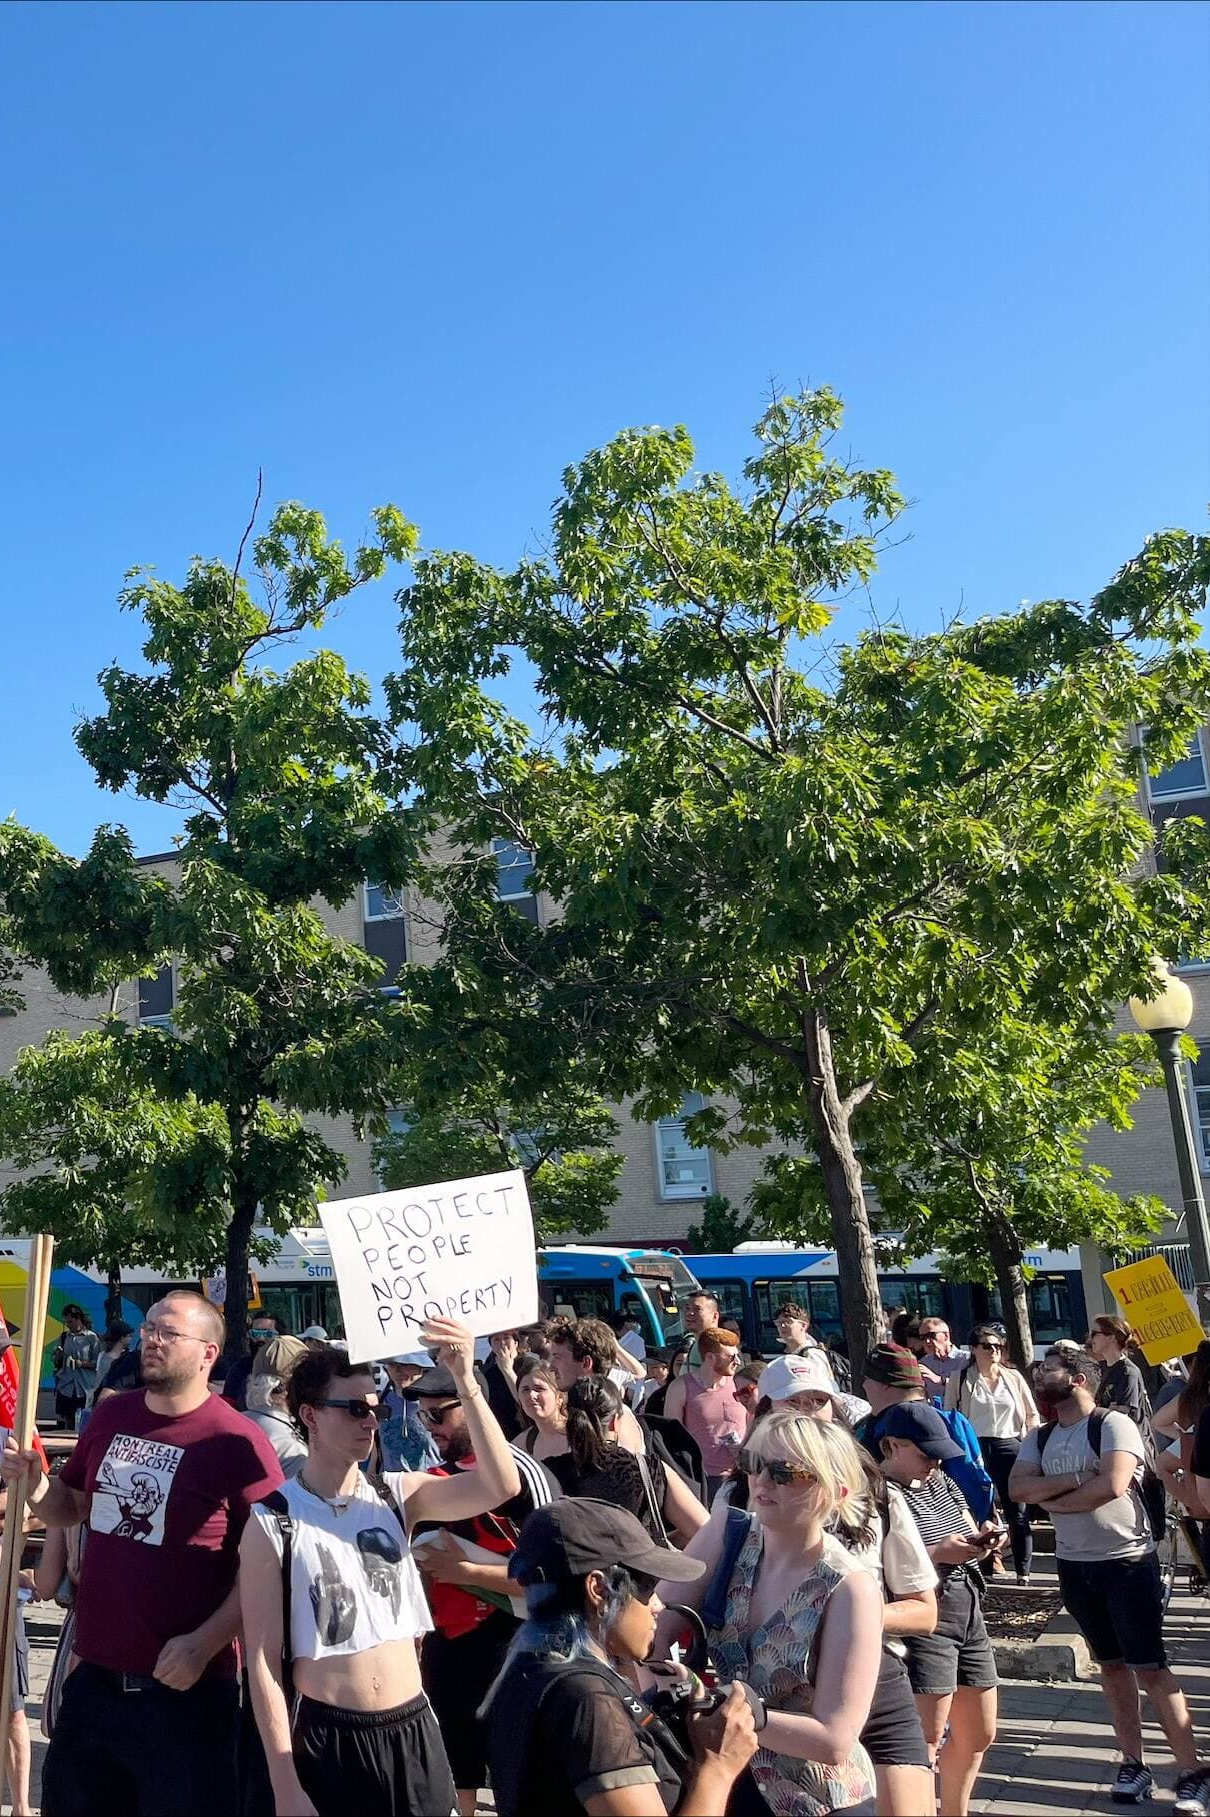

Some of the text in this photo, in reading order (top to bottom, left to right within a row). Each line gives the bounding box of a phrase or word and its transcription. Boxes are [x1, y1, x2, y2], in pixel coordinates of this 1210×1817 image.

[347, 1187, 514, 1243] PROTECT
[308, 1264, 333, 1277] stm
[362, 1233, 472, 1274] PEOPLE
[371, 1271, 428, 1301] NOT
[1118, 1287, 1133, 1305] 1
[377, 1276, 513, 1336] PROPERTY
